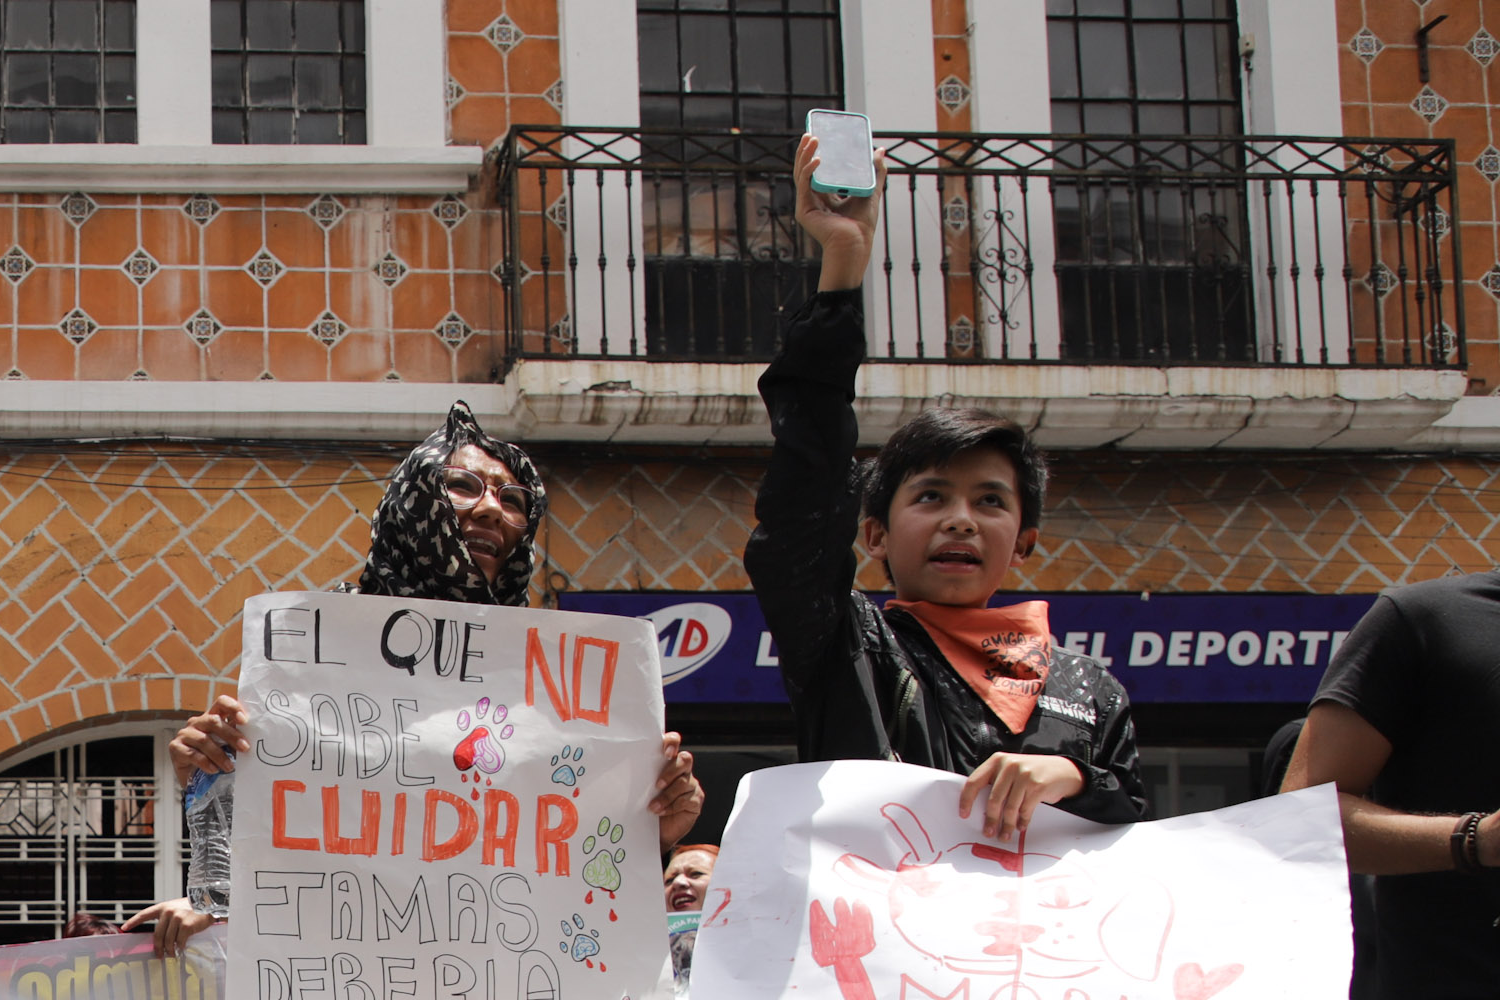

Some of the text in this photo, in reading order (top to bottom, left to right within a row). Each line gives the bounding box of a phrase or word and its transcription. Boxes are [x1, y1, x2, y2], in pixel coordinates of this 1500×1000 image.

[264, 607, 619, 727] EL QUE NO
[257, 690, 434, 787] SABE
[272, 780, 579, 877] CUIDAR
